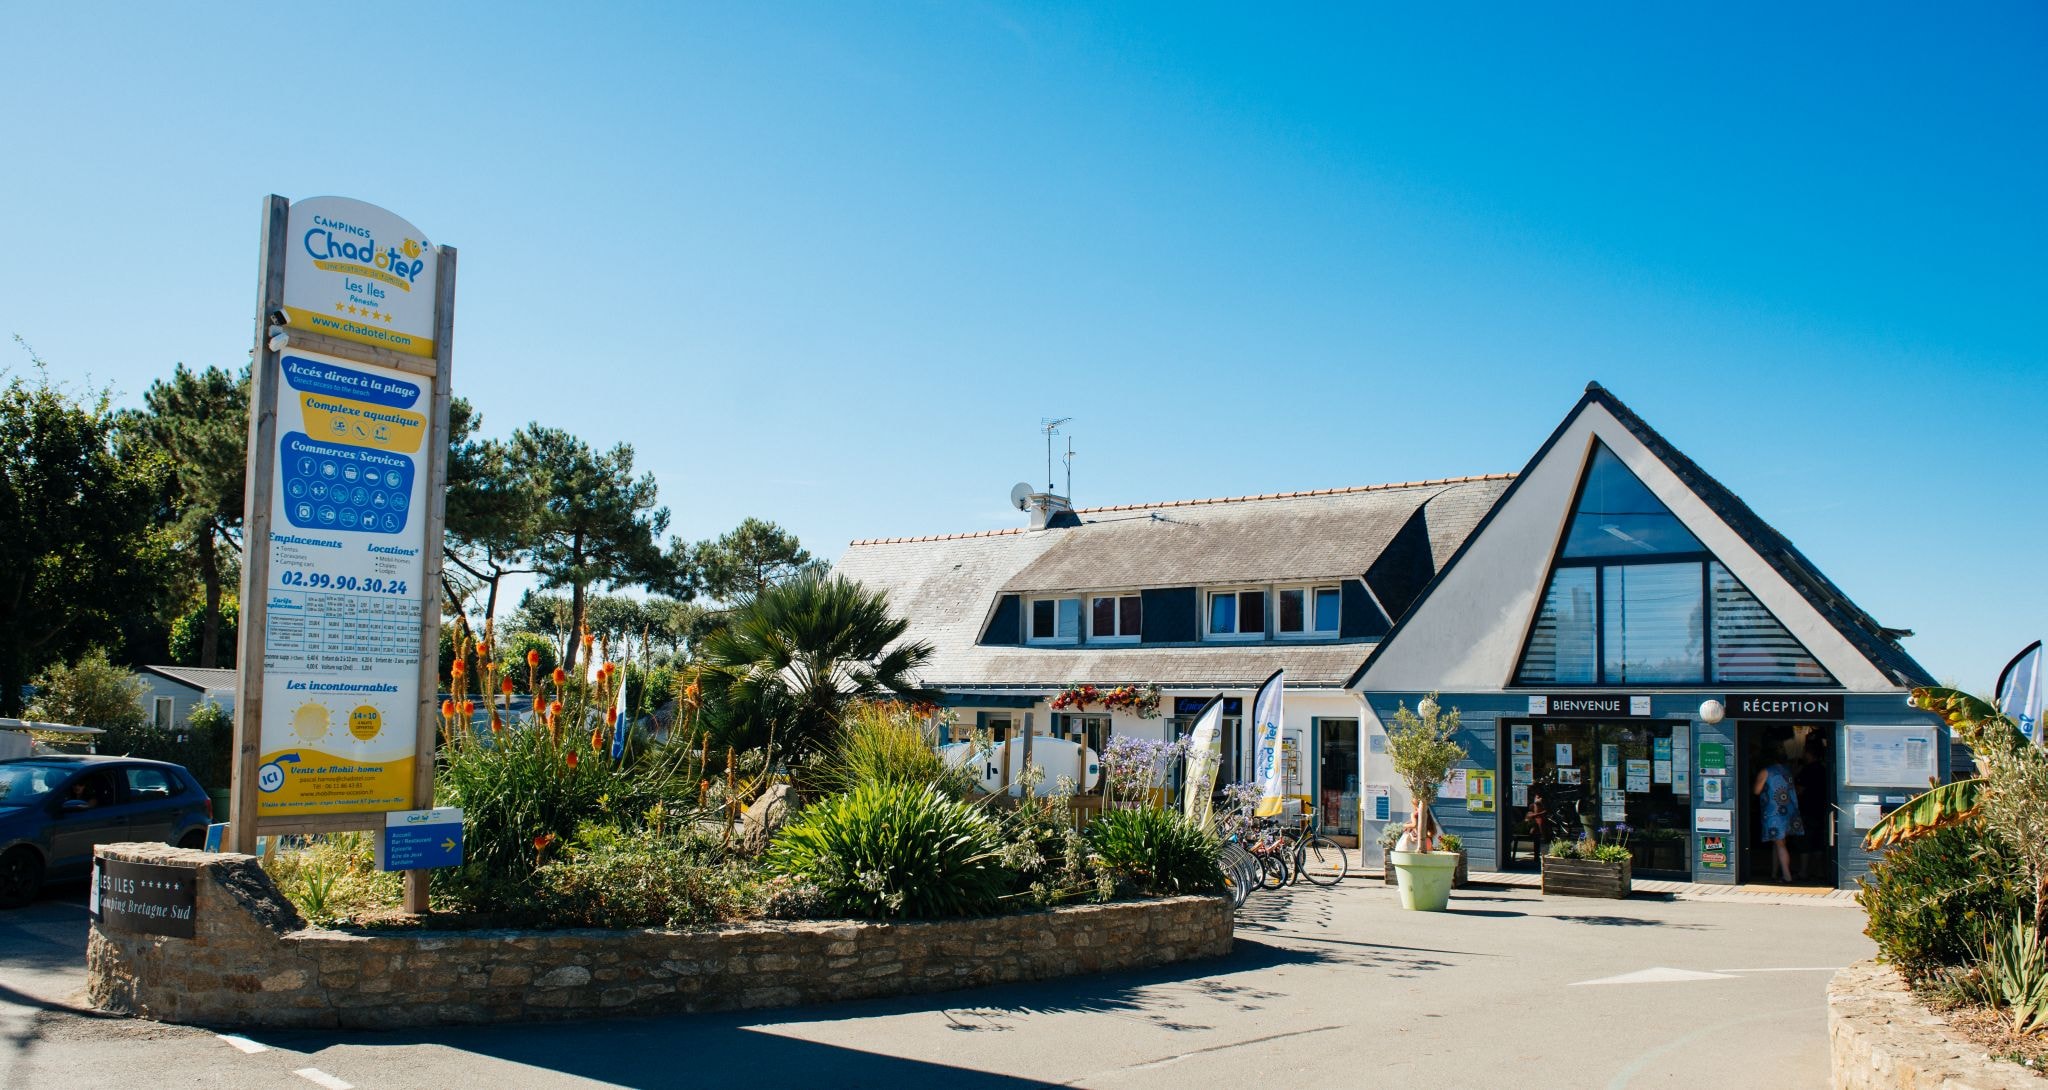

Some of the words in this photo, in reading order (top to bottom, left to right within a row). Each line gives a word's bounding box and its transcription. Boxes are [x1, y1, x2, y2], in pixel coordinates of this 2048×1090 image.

[314, 216, 370, 238] CAMPINGS
[304, 228, 424, 282] Chadotel
[346, 278, 363, 294] Les
[367, 283, 385, 299] Iles
[350, 295, 378, 308] Pénestin
[312, 316, 411, 345] www.chadotel.com
[293, 376, 312, 385] Direct
[313, 380, 333, 390] access
[352, 387, 370, 397] beach
[325, 370, 358, 385] direct
[361, 376, 369, 387] à
[371, 380, 382, 390] la
[384, 383, 415, 398] plage
[306, 398, 361, 417] Complexe
[363, 410, 420, 427] aquatique
[269, 532, 343, 549] Emplacements
[282, 570, 407, 595] 02.99.90.30.24
[287, 680, 306, 690] Les
[309, 681, 398, 692] incontournables
[1553, 700, 1620, 711] BIENVENUE
[1742, 698, 1830, 713] RÉCEPTION
[1264, 722, 1278, 780] Chadotel
[262, 772, 278, 785] ICI
[100, 874, 111, 890] LES
[114, 878, 134, 894] ILES
[128, 901, 168, 919] Bretagne
[170, 905, 190, 920] Sud
